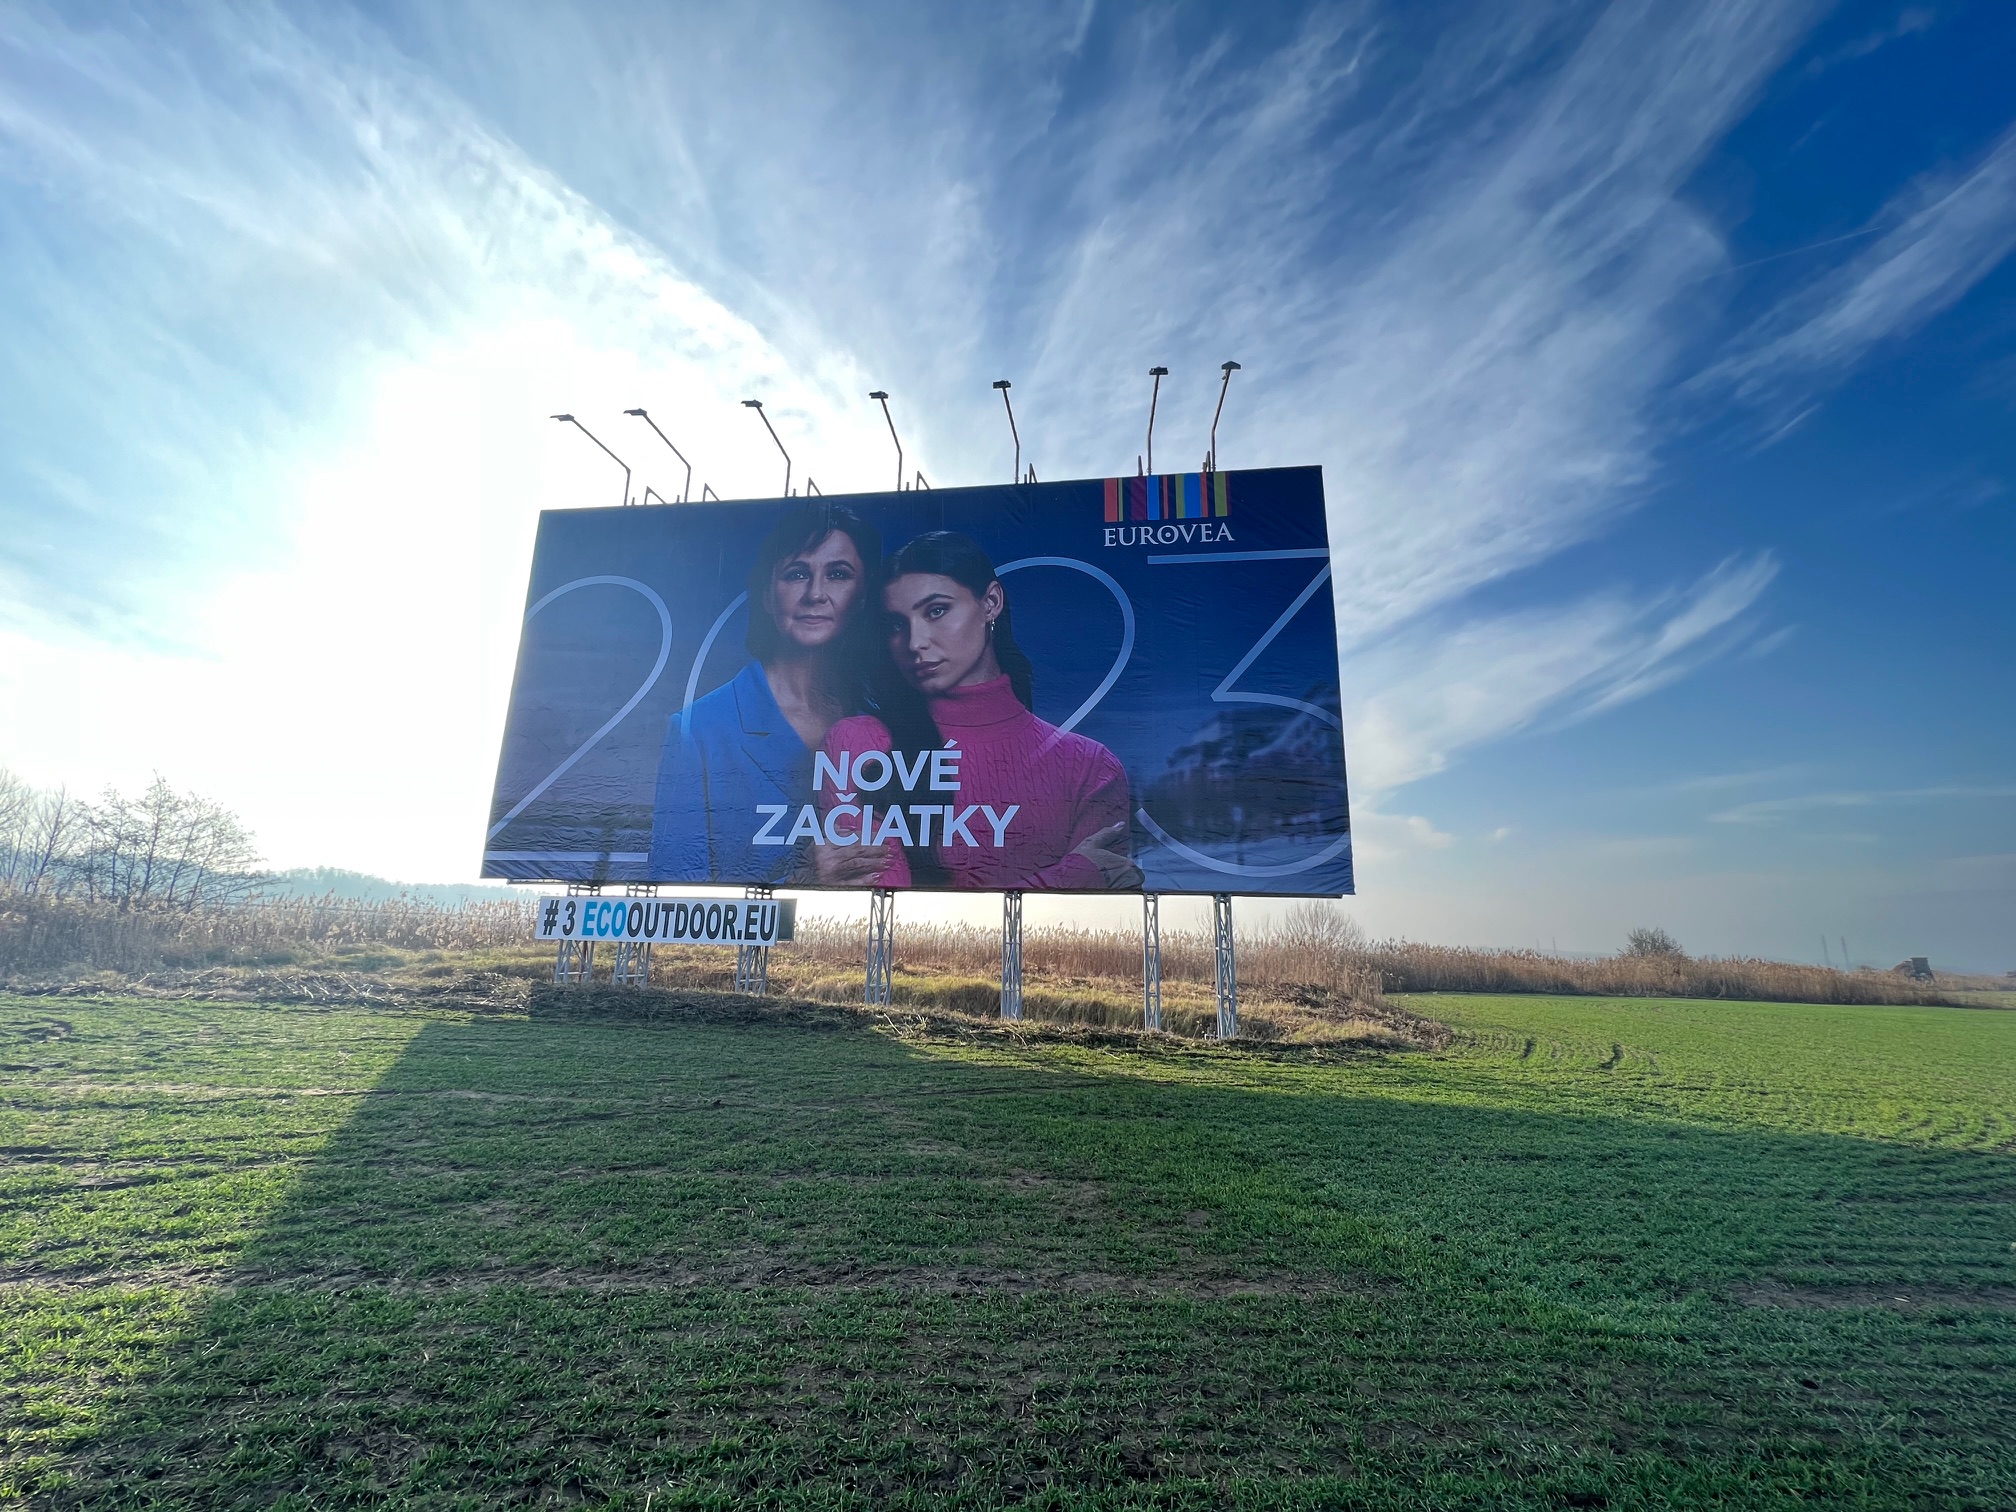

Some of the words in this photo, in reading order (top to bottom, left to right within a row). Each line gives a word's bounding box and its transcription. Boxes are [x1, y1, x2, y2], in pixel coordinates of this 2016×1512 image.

[1103, 522, 1235, 547] EUROVEA
[812, 738, 962, 791] NOVÉ
[752, 792, 1021, 848] ZAČIATKY
[581, 901, 777, 942] ECOOUTDOOR.EU
